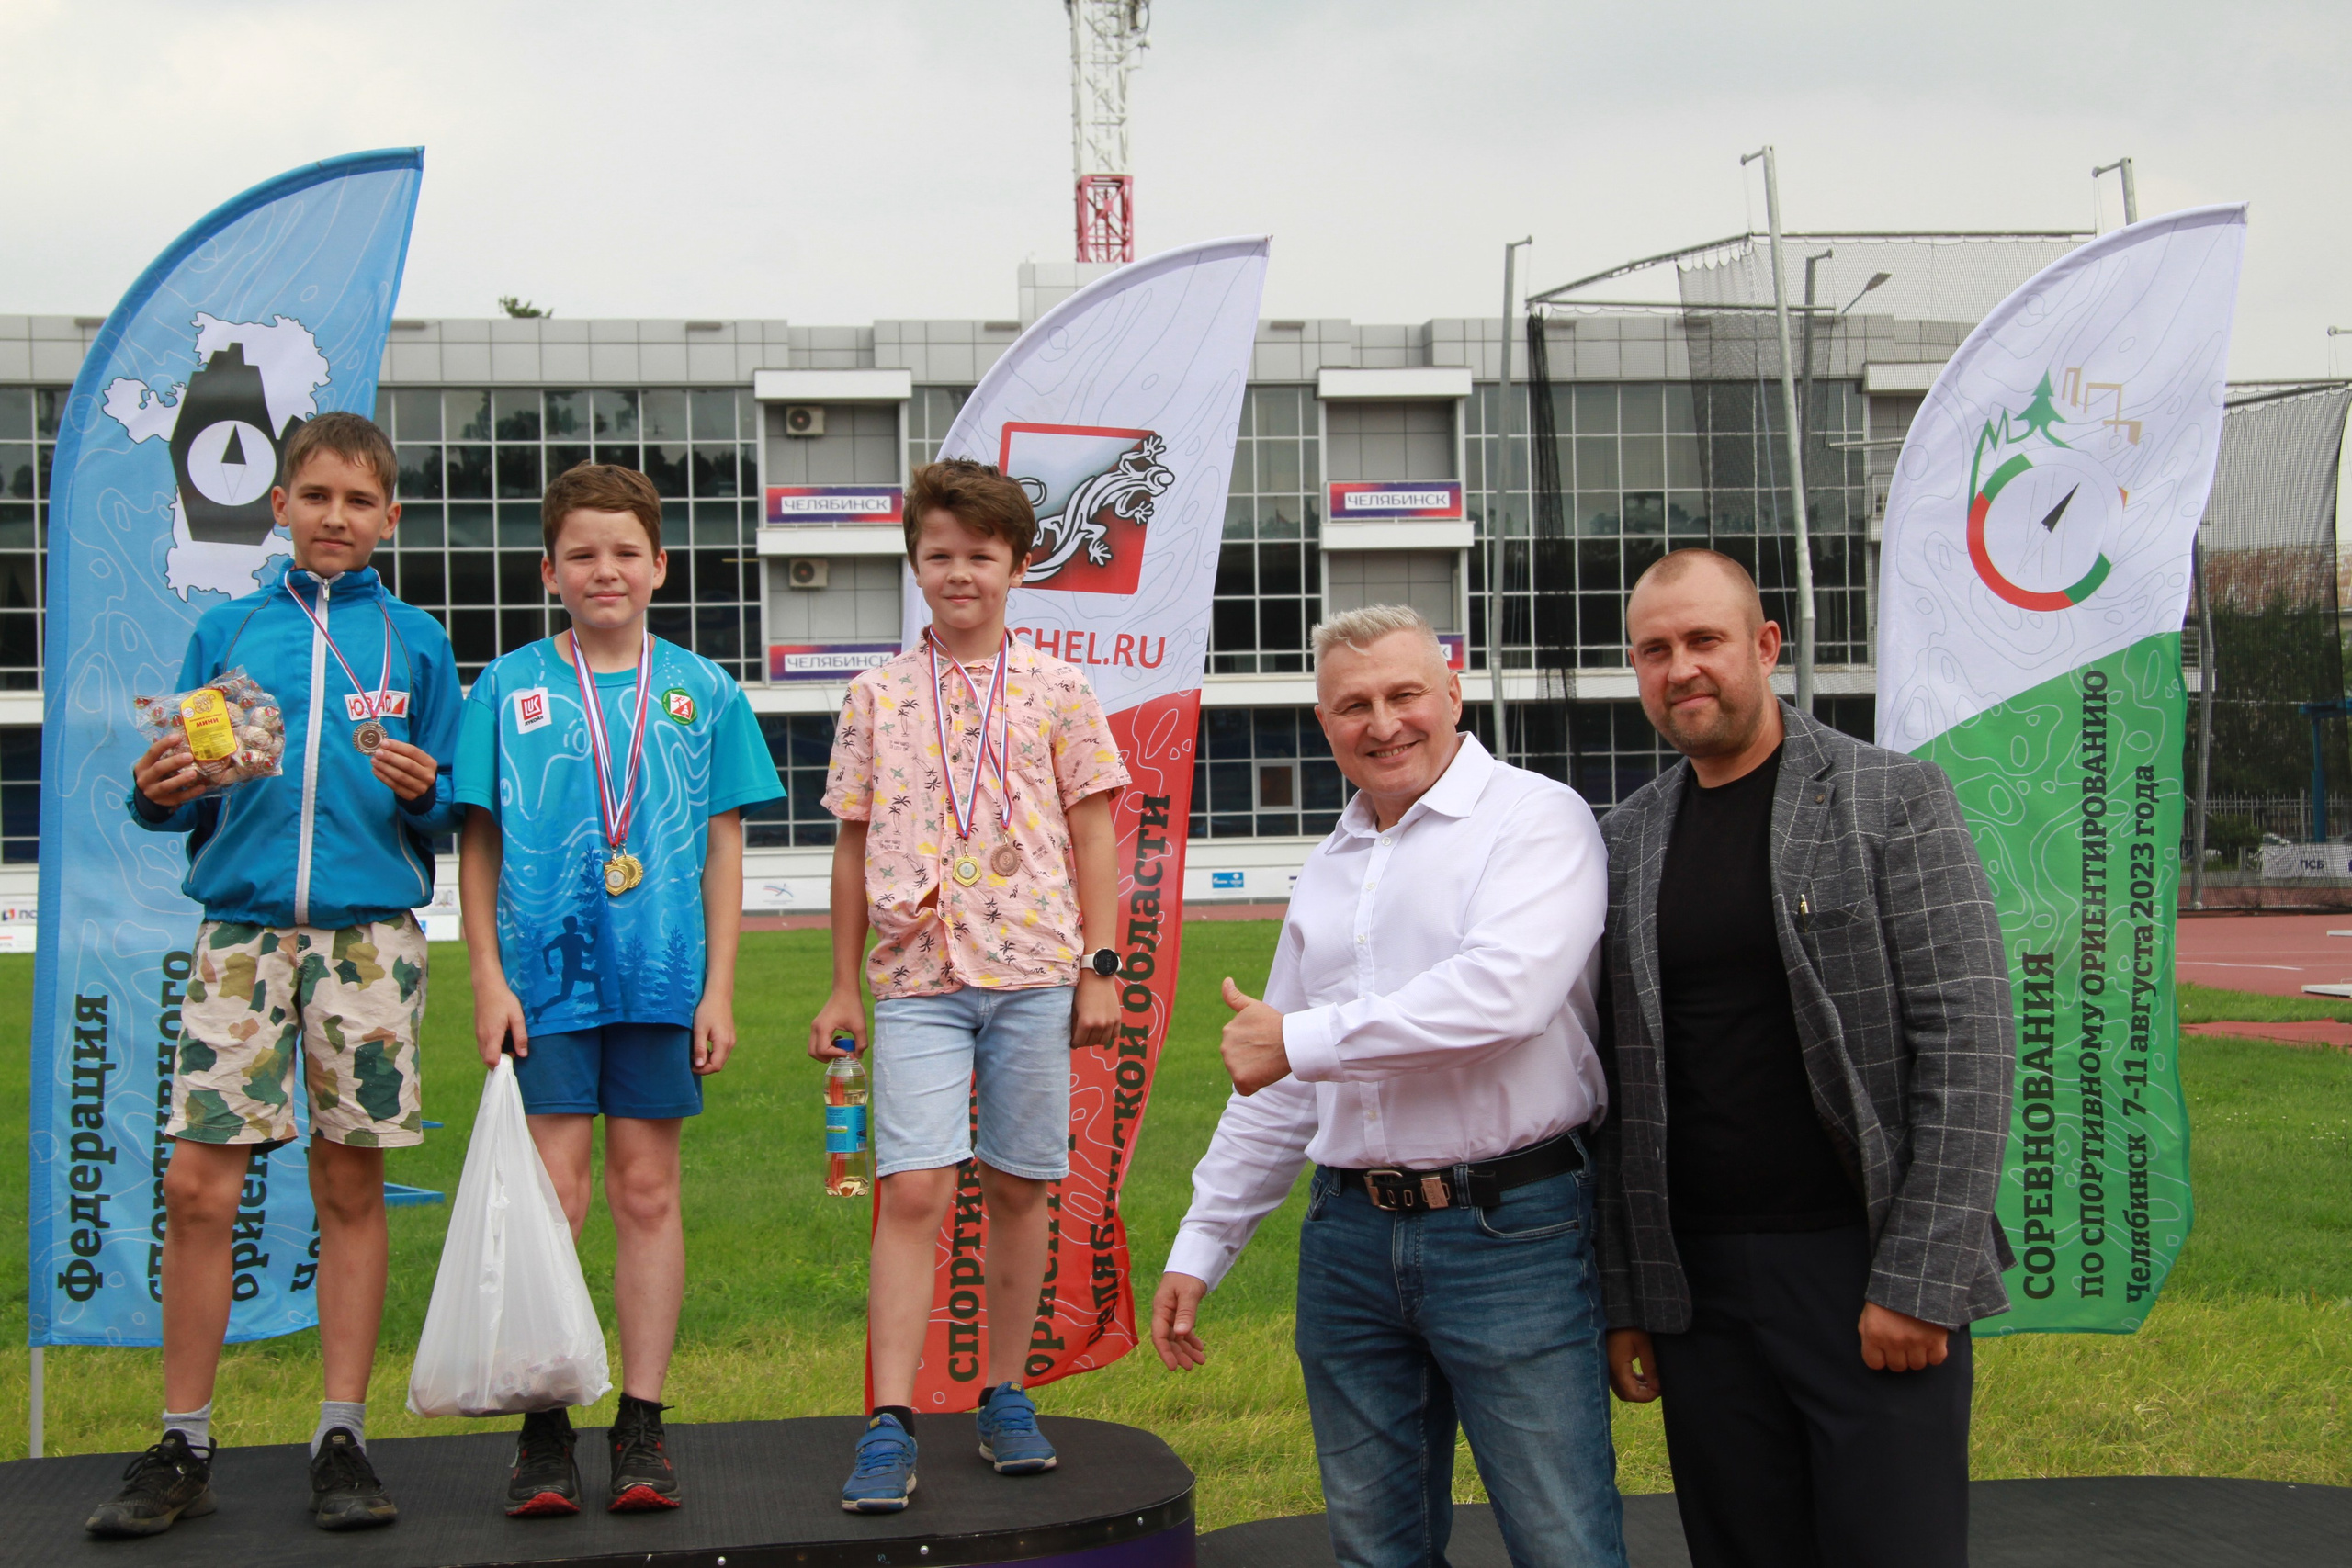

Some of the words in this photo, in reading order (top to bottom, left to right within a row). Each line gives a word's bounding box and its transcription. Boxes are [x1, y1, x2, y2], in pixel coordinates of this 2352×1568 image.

[784, 498, 888, 511] ЧЕЛЯБИНСК
[1347, 493, 1446, 506] ЧЕЛЯБИНСК
[2080, 670, 2108, 996] ОРИЕНТИРОВАНИЮ
[2135, 764, 2160, 836] года
[1117, 794, 1170, 1013] области
[2130, 841, 2154, 919] 2023
[2300, 859, 2324, 870] ПСБ
[2130, 924, 2157, 1053] августа
[2022, 951, 2056, 1300] СОРЕВНОВАНИЯ
[2078, 1000, 2105, 1246] СПОРТИВНОМУ
[2122, 1058, 2148, 1117] 7-11
[57, 993, 117, 1303] Федерация
[2122, 1133, 2152, 1303] Челябинск
[2080, 1252, 2105, 1299] ПО
